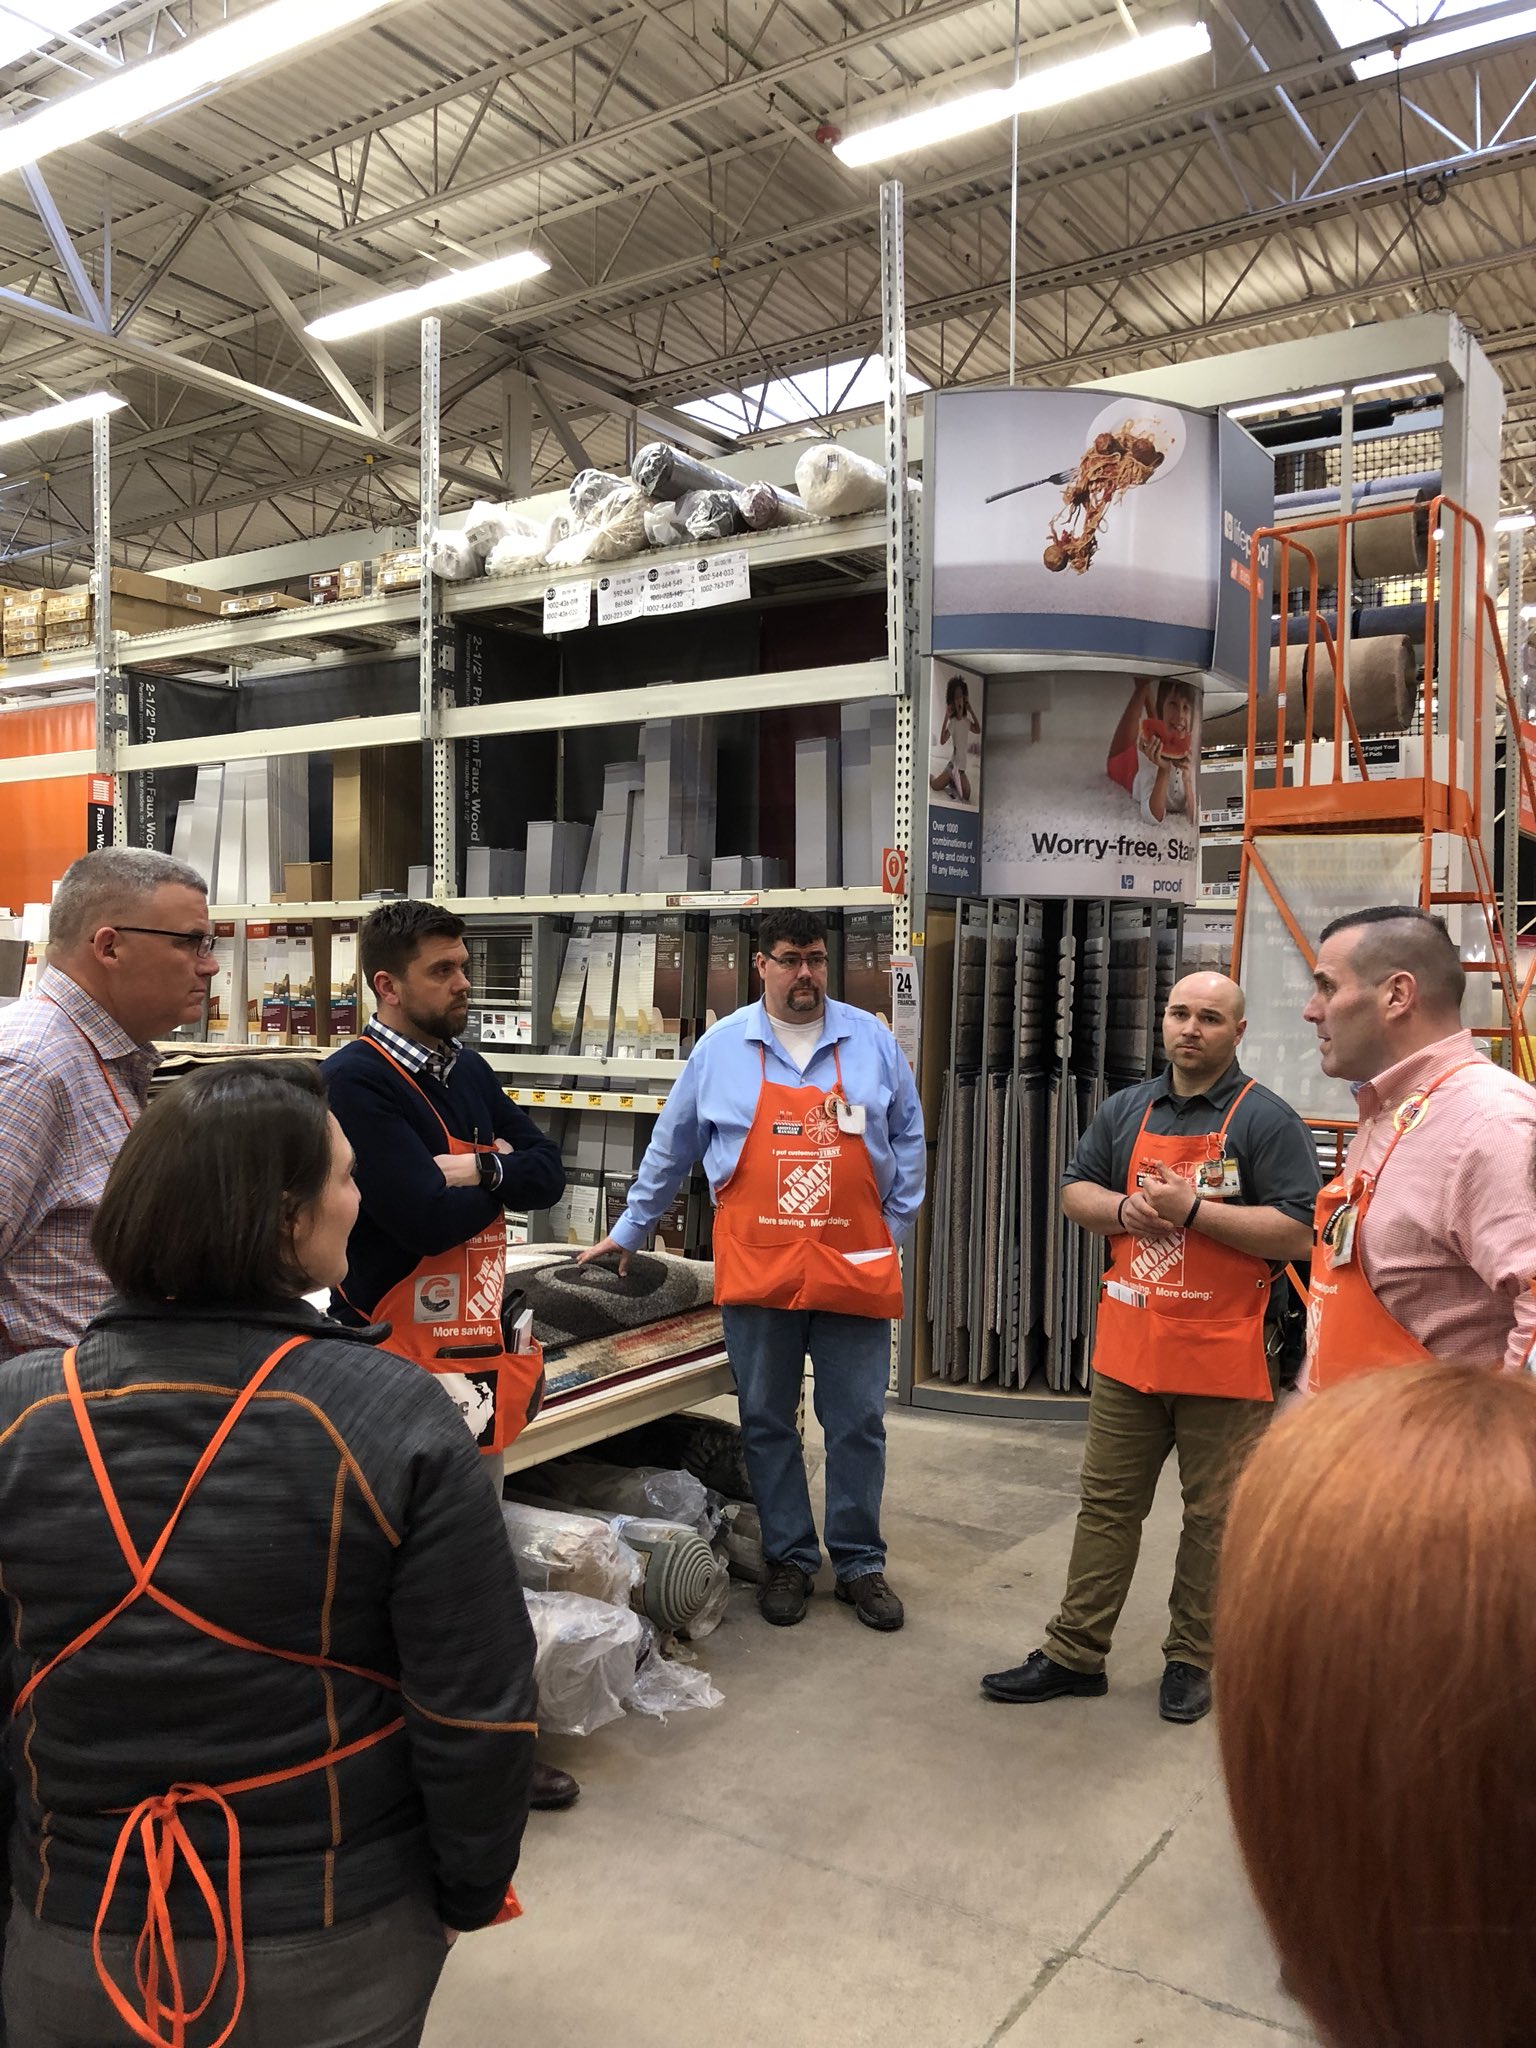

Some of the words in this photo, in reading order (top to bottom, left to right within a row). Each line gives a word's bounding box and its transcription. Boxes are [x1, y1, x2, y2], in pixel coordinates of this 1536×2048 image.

[650, 579, 683, 590] 1001-664-549
[699, 568, 734, 582] 1002-544-033
[472, 758, 482, 794] Faux
[146, 787, 157, 818] Faux
[96, 808, 105, 832] Faux
[471, 798, 481, 841] Wood
[932, 820, 945, 831] Over
[946, 823, 958, 834] 1000
[96, 833, 105, 850] Wo
[146, 821, 157, 850] Woo
[932, 837, 967, 849] combinations
[967, 840, 974, 850] of
[932, 850, 945, 862] style
[945, 852, 956, 862] and
[956, 853, 969, 863] color
[969, 855, 976, 864] to
[1031, 833, 1162, 862] Worry-free,
[938, 866, 948, 877] any
[1153, 878, 1182, 894] proof
[896, 972, 912, 993] 24
[819, 1148, 841, 1157] FIRST
[783, 1165, 806, 1188] THE
[779, 1160, 831, 1214] HOME
[798, 1180, 831, 1215] DEPOT
[758, 1216, 777, 1226] More
[778, 1217, 806, 1228] saving.
[811, 1218, 827, 1227] Mor
[827, 1217, 850, 1227] doing.
[473, 1255, 494, 1286] THE
[1149, 1248, 1184, 1283] DEPOT
[1156, 1287, 1179, 1298] More
[1181, 1290, 1212, 1301] doing.
[433, 1326, 459, 1337] More
[461, 1325, 496, 1336] saving.
